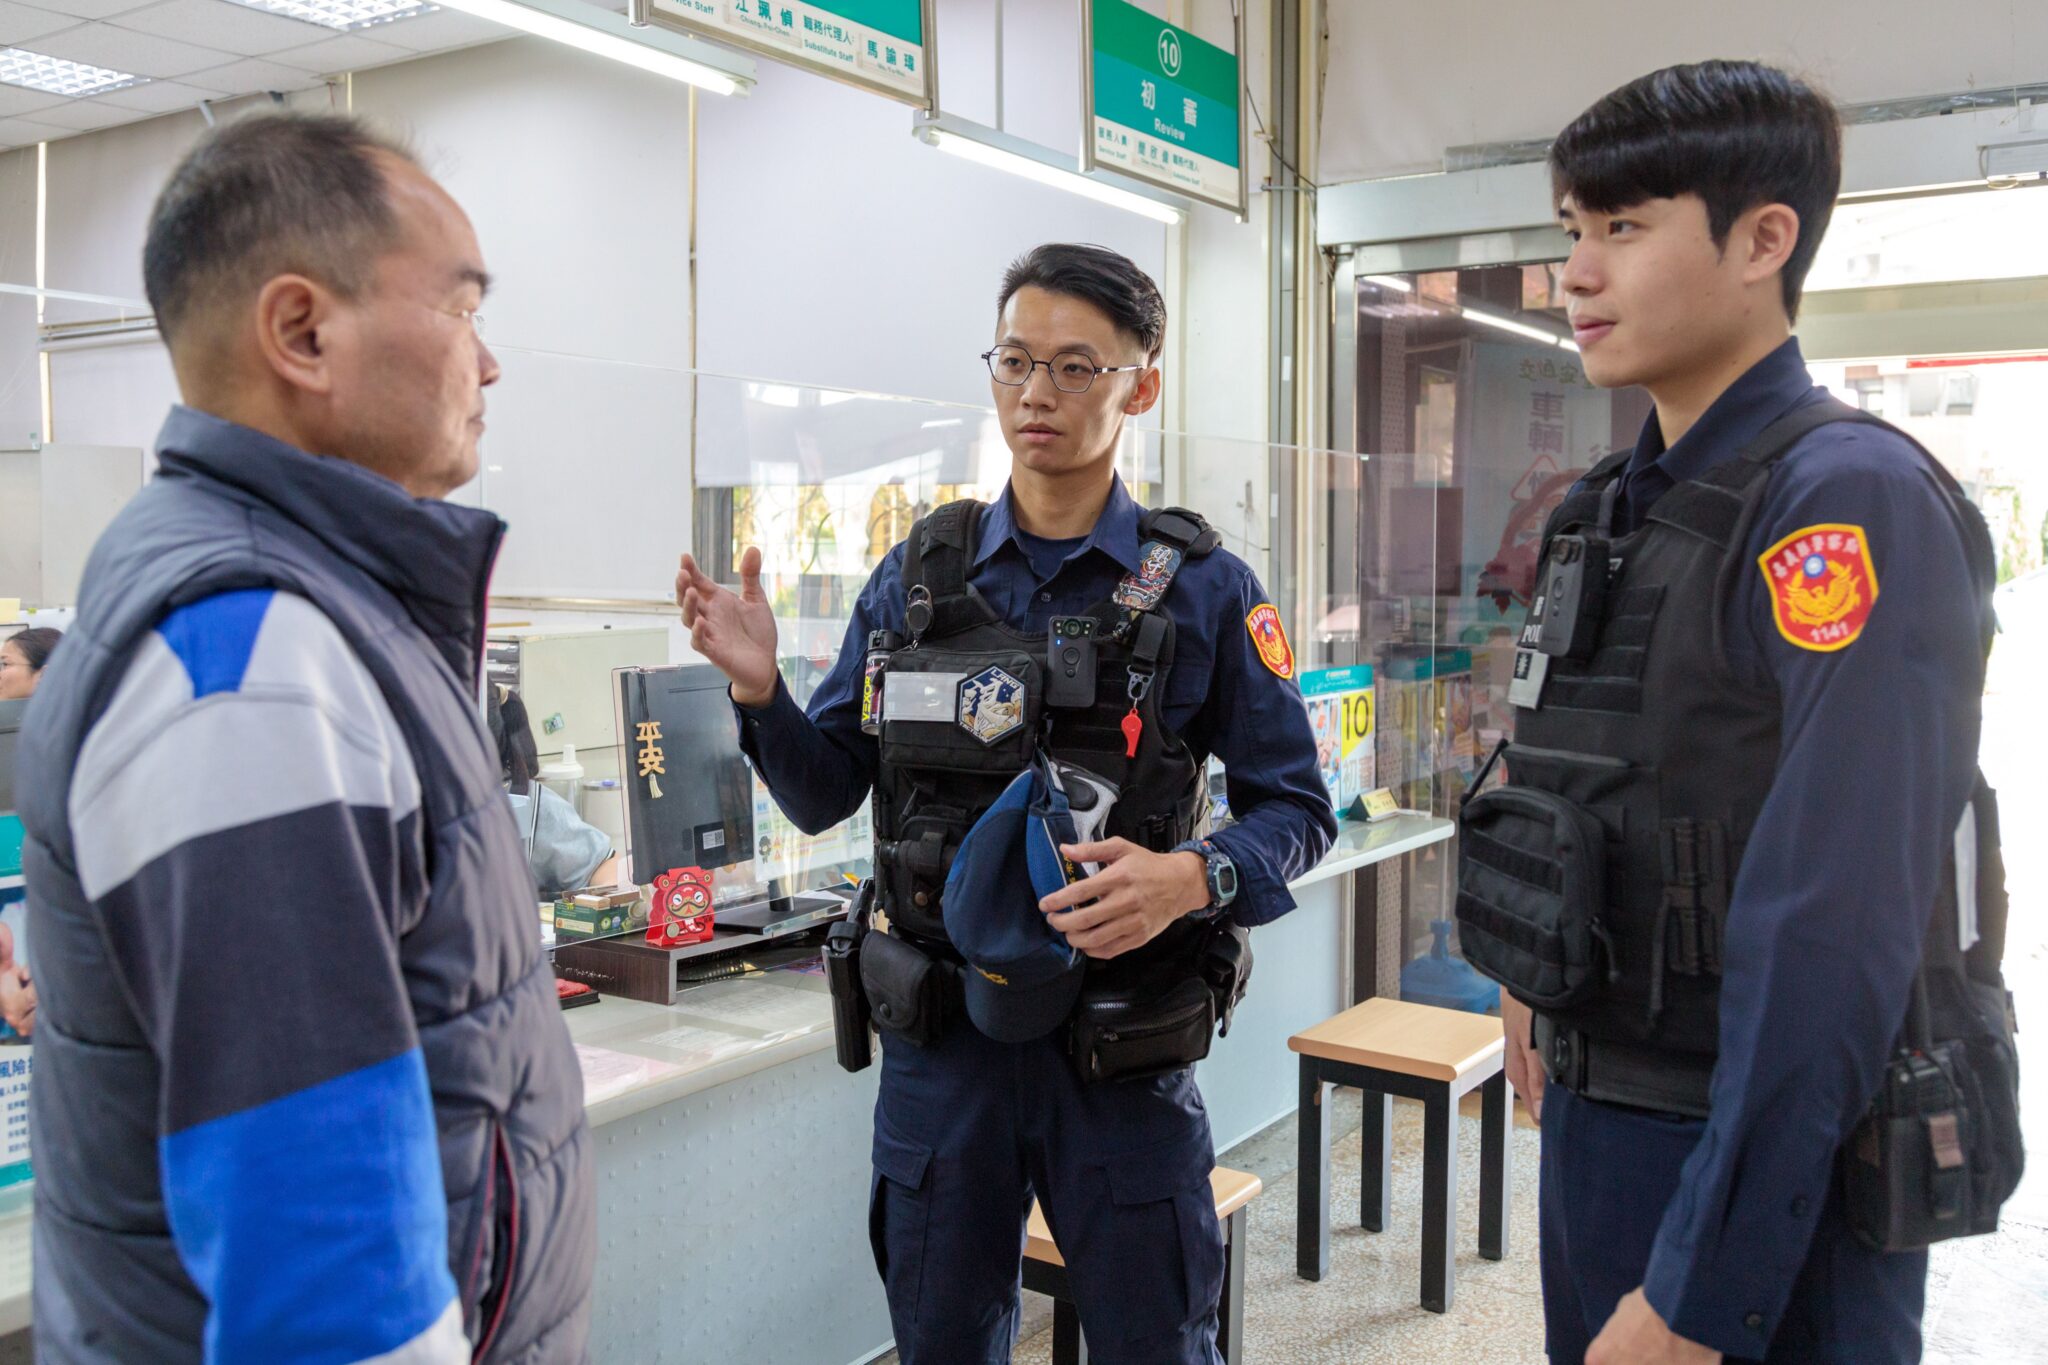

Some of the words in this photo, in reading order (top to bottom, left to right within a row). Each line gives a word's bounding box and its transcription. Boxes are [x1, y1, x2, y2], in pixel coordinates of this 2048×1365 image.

[694, 1, 714, 15] Staff
[804, 39, 837, 57] Substitute
[839, 51, 854, 63] Staff
[1161, 39, 1177, 68] 10
[1141, 79, 1198, 128] 初審
[1154, 117, 1185, 142] Review
[1518, 358, 1597, 390] 交通安
[1528, 391, 1565, 454] 車輛
[1811, 621, 1849, 642] 1141
[990, 669, 1020, 689] LANG
[861, 676, 873, 721] VEXOR
[1343, 695, 1369, 740] 10
[635, 721, 667, 777] 平安
